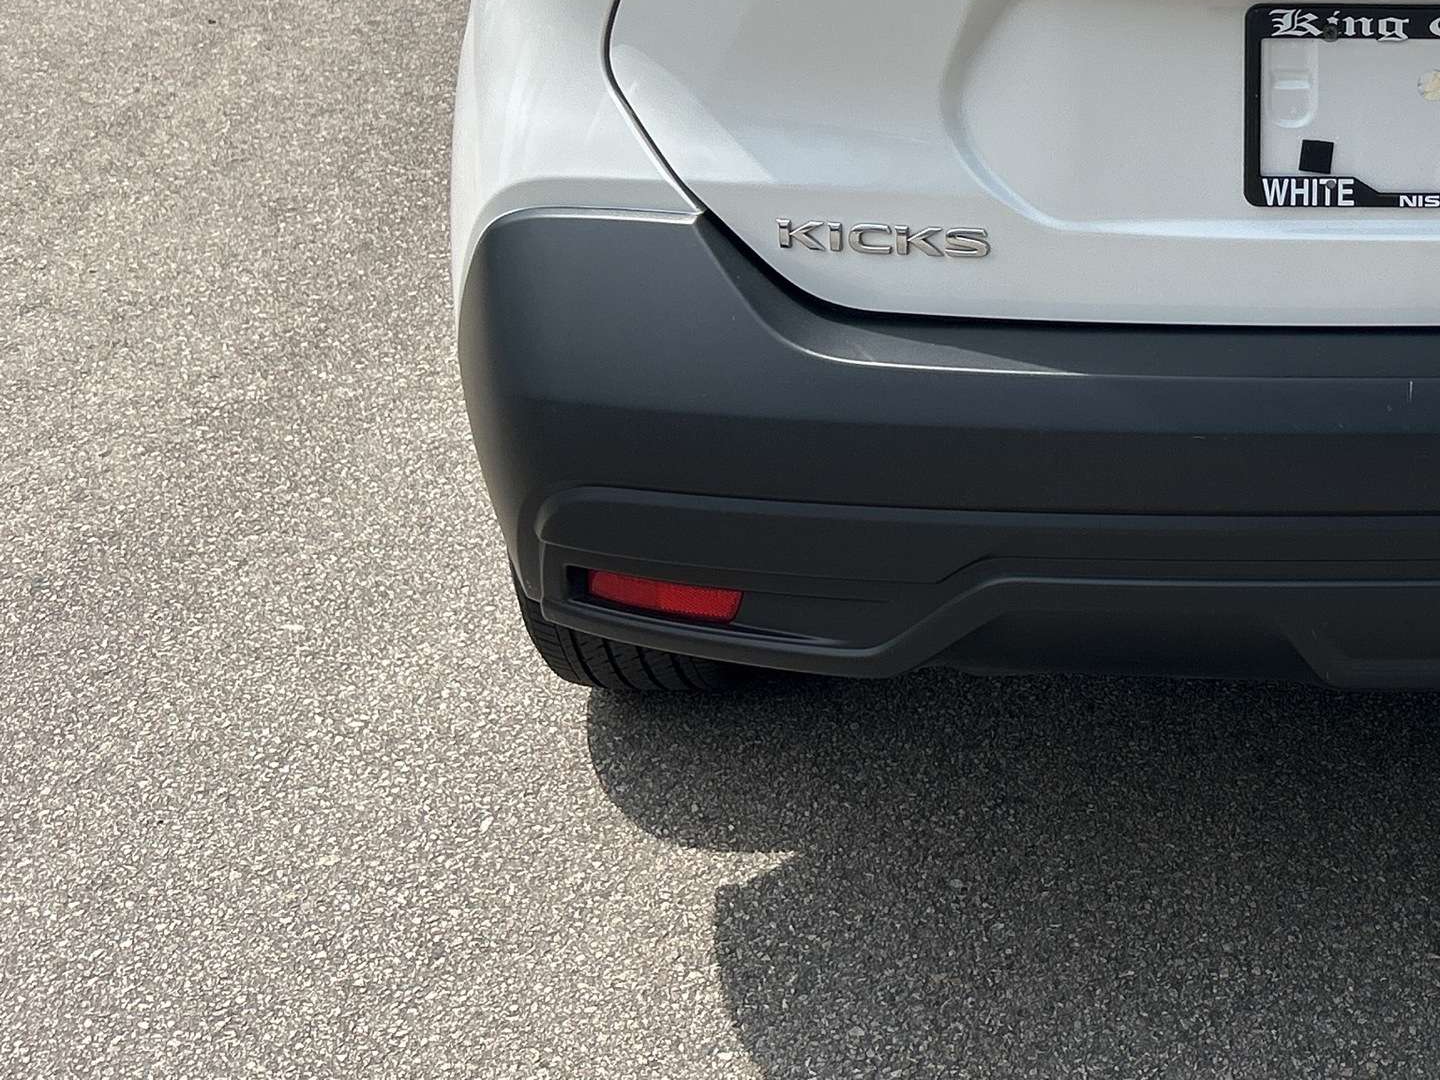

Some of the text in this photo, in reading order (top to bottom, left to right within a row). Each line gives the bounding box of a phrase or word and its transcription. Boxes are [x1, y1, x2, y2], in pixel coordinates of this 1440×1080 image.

[1269, 9, 1410, 42] King
[1262, 178, 1355, 207] WHITE
[775, 218, 992, 258] KICKS
